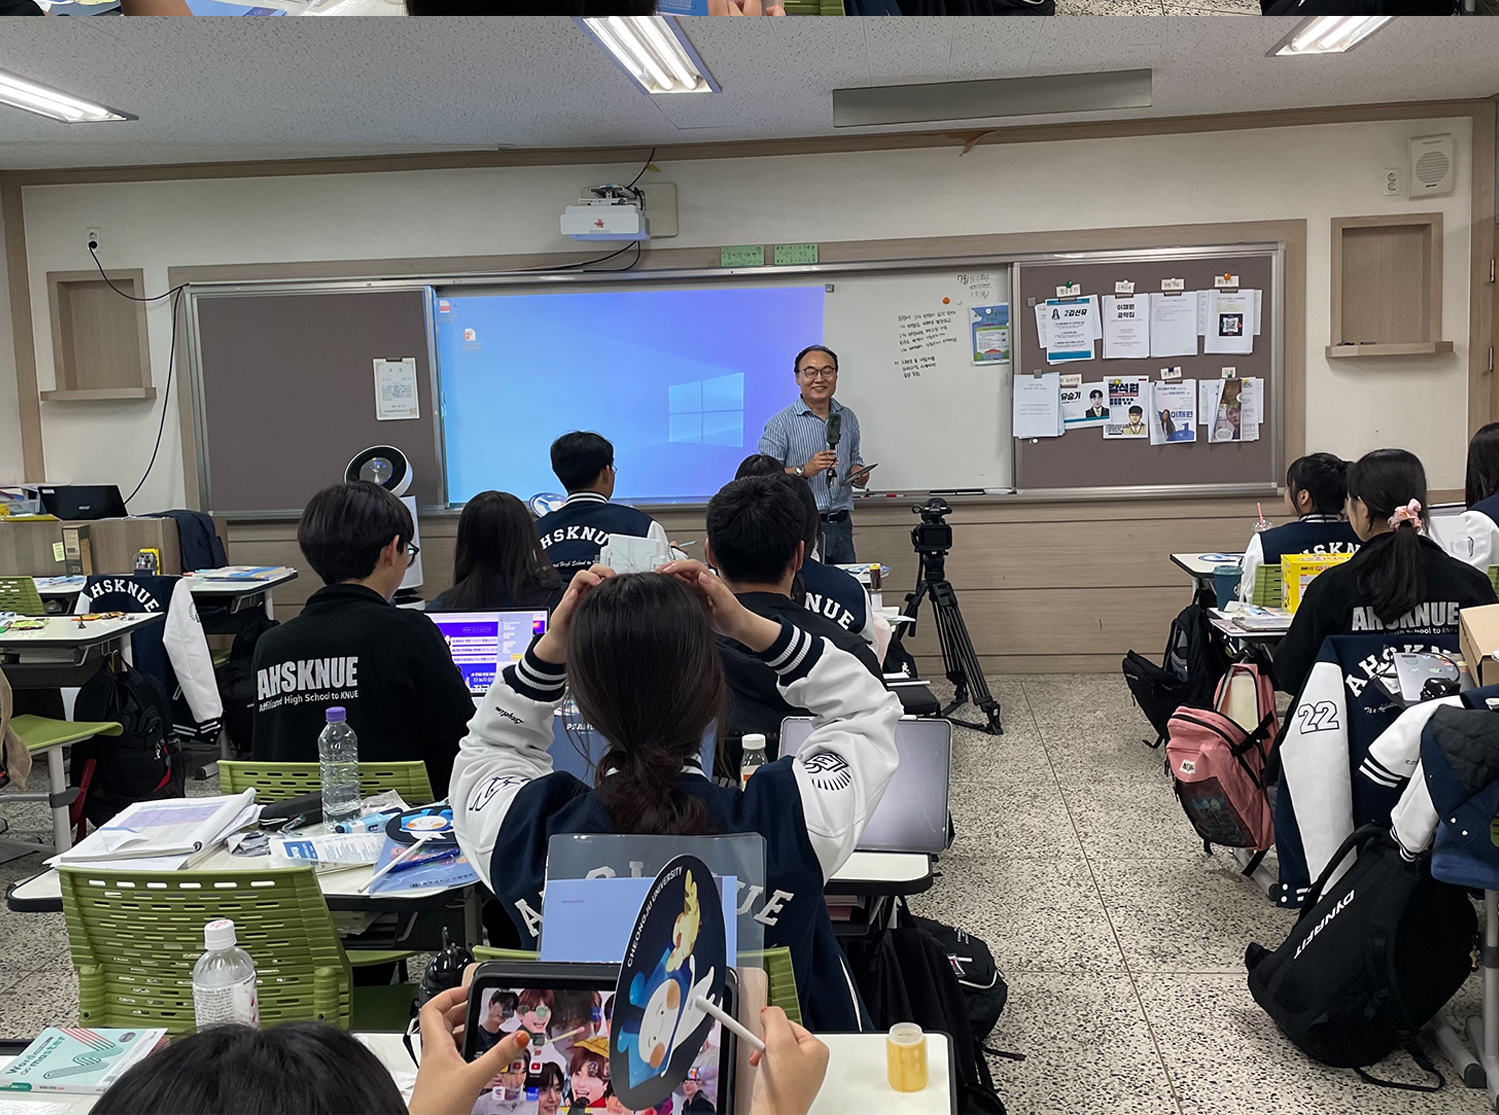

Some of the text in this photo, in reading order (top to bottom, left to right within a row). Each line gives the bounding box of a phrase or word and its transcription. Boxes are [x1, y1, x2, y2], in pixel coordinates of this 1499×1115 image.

[257, 656, 358, 701] AHSKNUE
[284, 692, 303, 704] High
[304, 692, 330, 702] School
[331, 692, 339, 701] to
[340, 690, 358, 700] KNUE
[1298, 701, 1340, 736] 22
[627, 866, 683, 967] CHEONGJU UNIVERSITY
[1293, 889, 1354, 960] DYNAFIT
